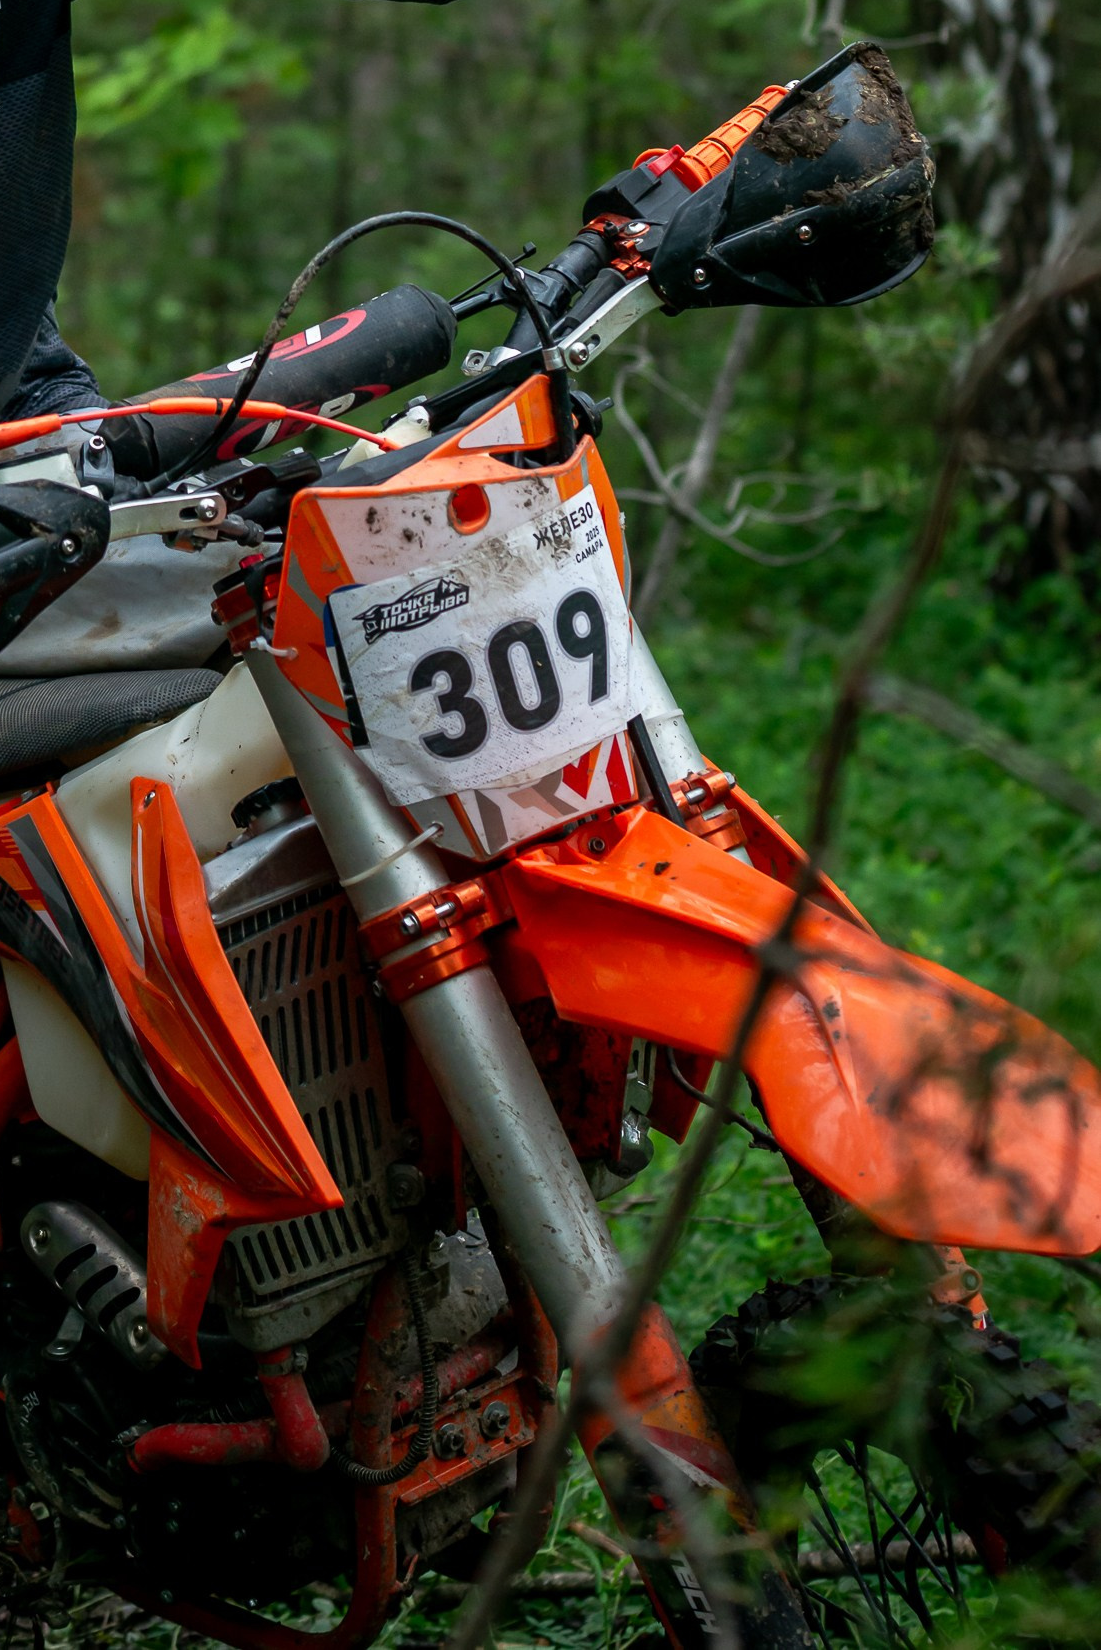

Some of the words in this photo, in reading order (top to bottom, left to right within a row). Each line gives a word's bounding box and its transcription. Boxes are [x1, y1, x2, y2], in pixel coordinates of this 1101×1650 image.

[532, 501, 594, 551] ЖЕЛЕЗО
[585, 525, 601, 543] 2025
[575, 538, 604, 564] САМАРА
[381, 591, 436, 618] ТОЧКА
[397, 591, 467, 626] ОТРЫВА
[408, 586, 612, 763] 309
